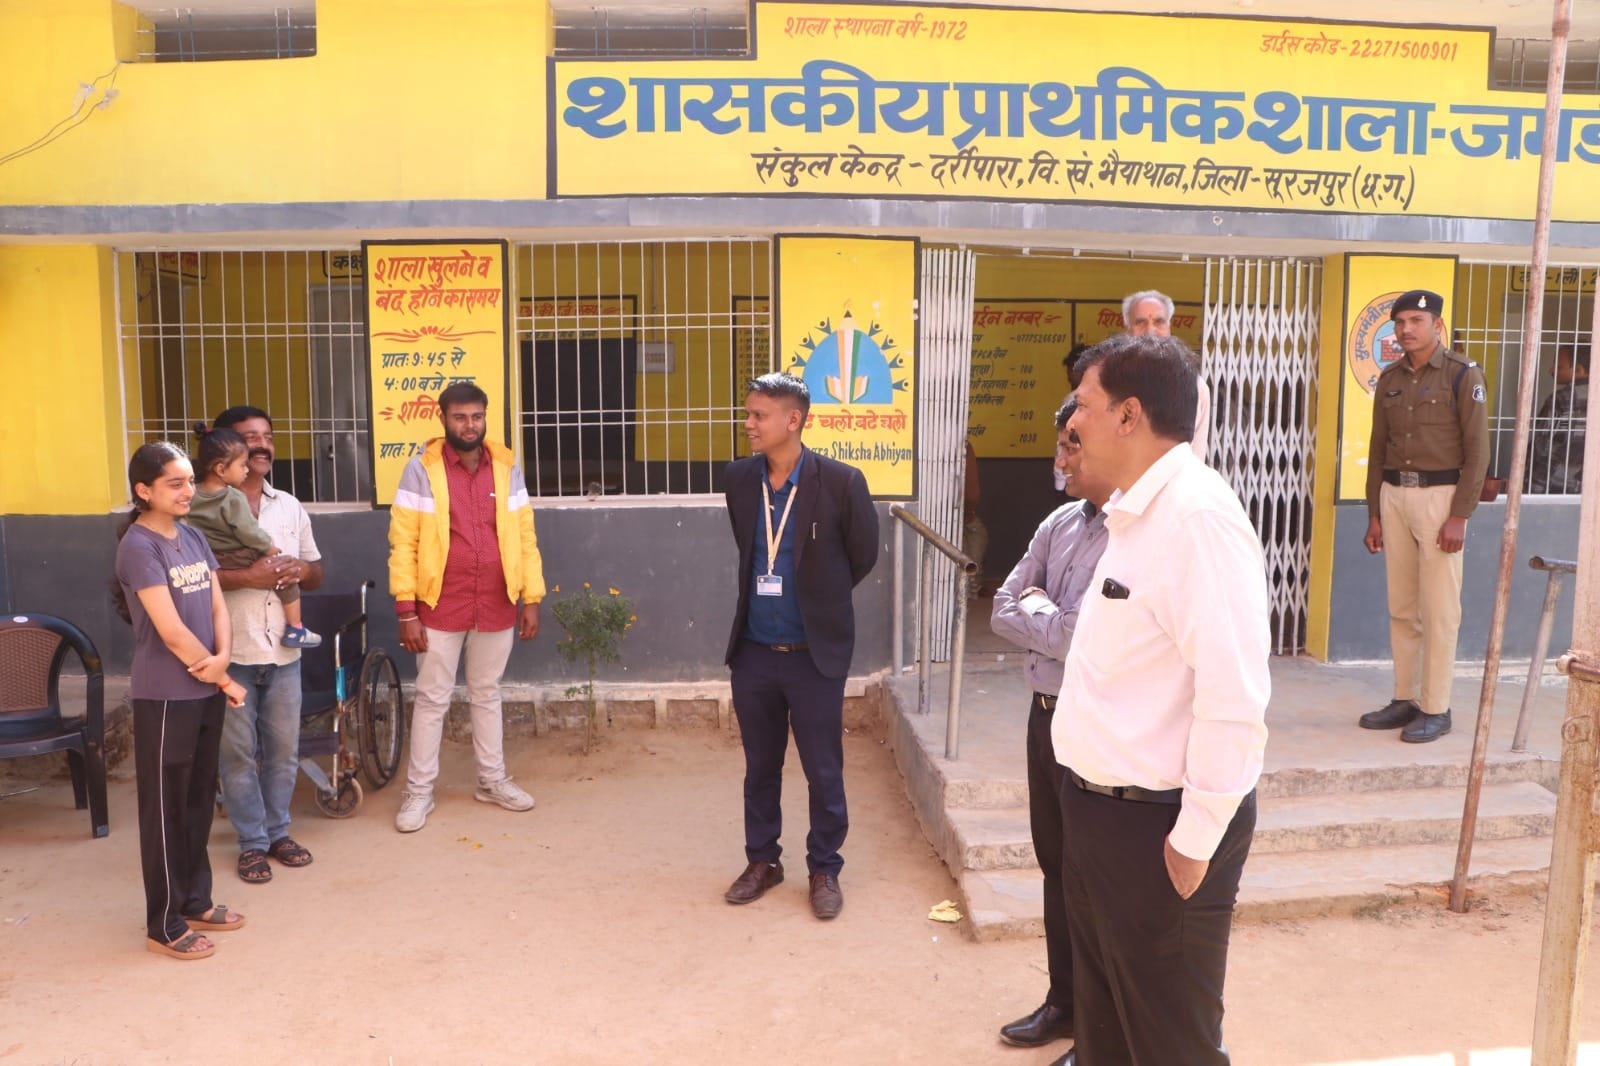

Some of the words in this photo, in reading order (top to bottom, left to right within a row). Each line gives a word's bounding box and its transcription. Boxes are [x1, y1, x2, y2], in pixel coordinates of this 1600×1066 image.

[784, 15, 831, 39] शाला
[832, 16, 895, 39] स्थापना
[563, 59, 950, 139] शासकीय
[952, 66, 1246, 149] प्राथमिक
[750, 146, 838, 188] संकुल
[838, 144, 906, 188] केन्द्र
[1027, 149, 1060, 185] वि.
[374, 257, 427, 284] शाला
[426, 248, 478, 289] खुलने
[476, 255, 494, 280] व
[375, 283, 408, 316] बंद
[407, 283, 446, 317] होने
[444, 288, 468, 309] का
[465, 288, 502, 315] समय
[450, 346, 467, 370] से
[417, 371, 447, 391] बजे
[831, 440, 872, 461] Shiksha
[873, 440, 912, 467] Abhiyan
